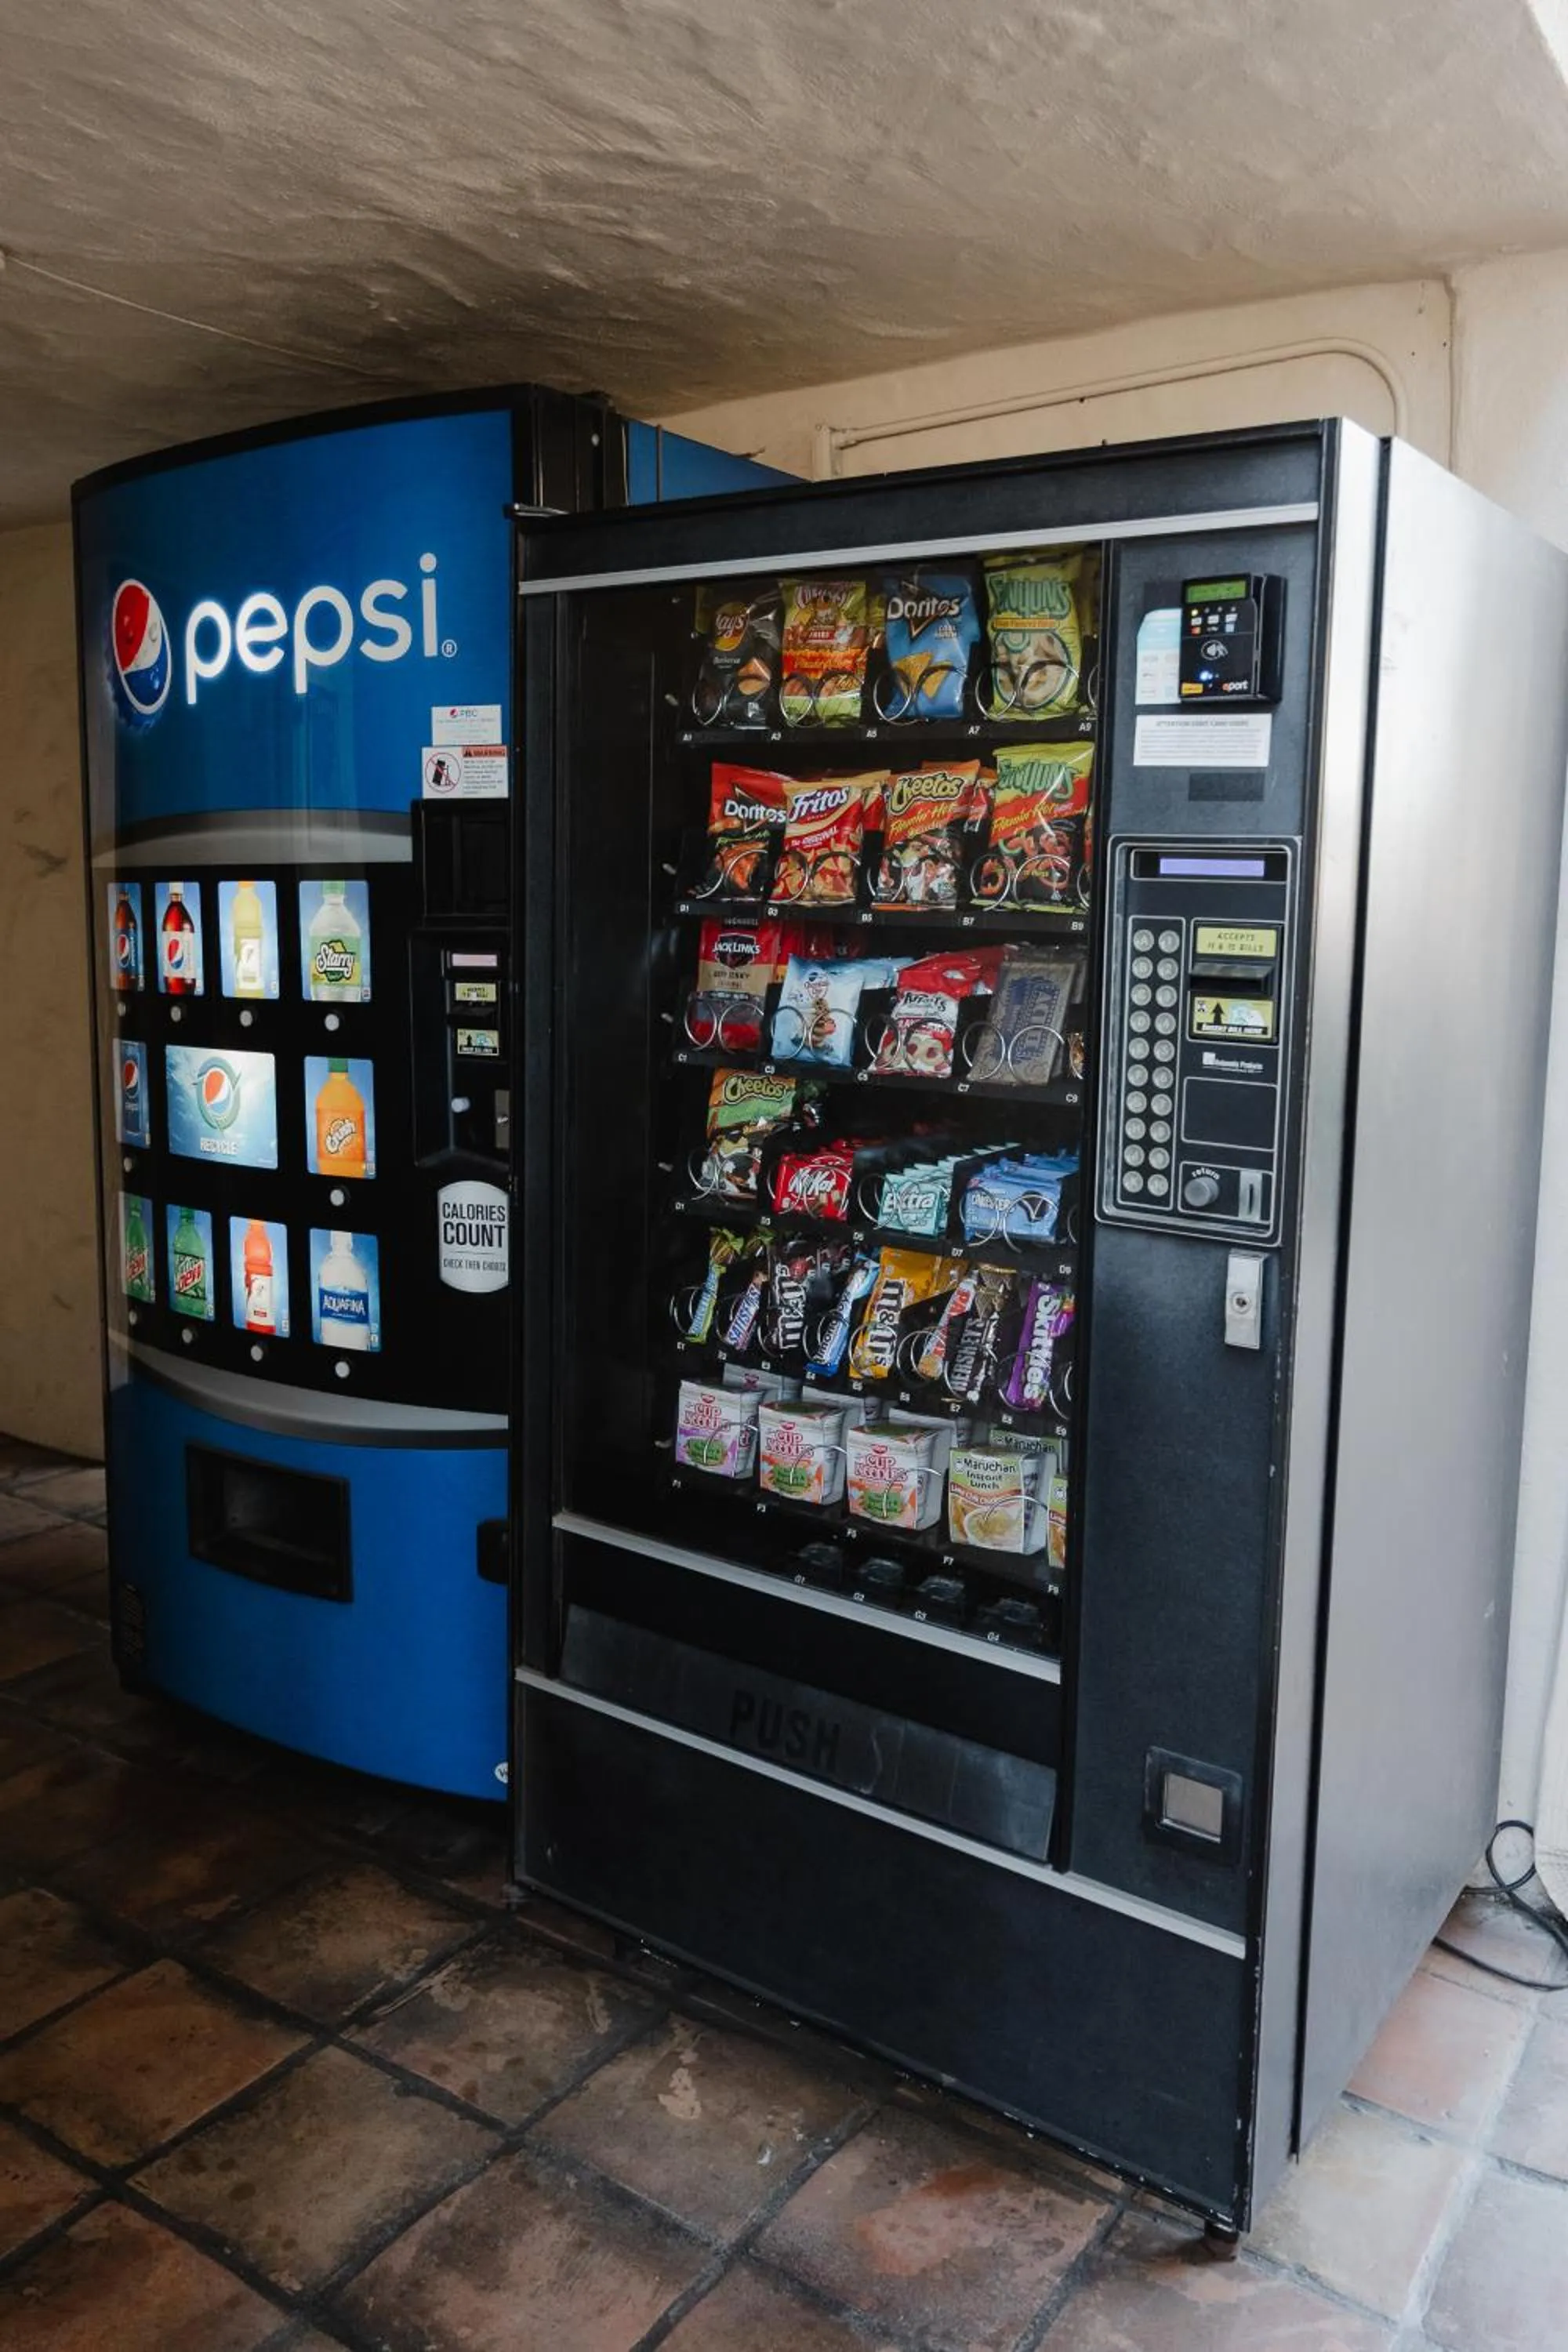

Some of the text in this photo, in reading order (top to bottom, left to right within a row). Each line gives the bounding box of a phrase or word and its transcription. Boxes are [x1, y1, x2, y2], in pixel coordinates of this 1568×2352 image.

[887, 596, 960, 620] Doritos
[185, 553, 437, 705] pepsi
[788, 786, 850, 823] Fritos
[891, 772, 963, 812] Cheetos
[724, 799, 786, 823] Doritos
[317, 943, 354, 978] Starry
[724, 1075, 783, 1104] Cheetos
[200, 1137, 238, 1155] RECYCLE
[442, 1202, 506, 1222] CALORIES
[443, 1221, 506, 1248] COUNT
[322, 1294, 366, 1316] AQUAFINA
[1023, 1294, 1060, 1399] Skittles
[964, 1457, 1017, 1473] Maruchan
[967, 1470, 1003, 1483] Instant
[970, 1480, 1000, 1490] Lunch
[731, 1690, 840, 1774] PUSH
